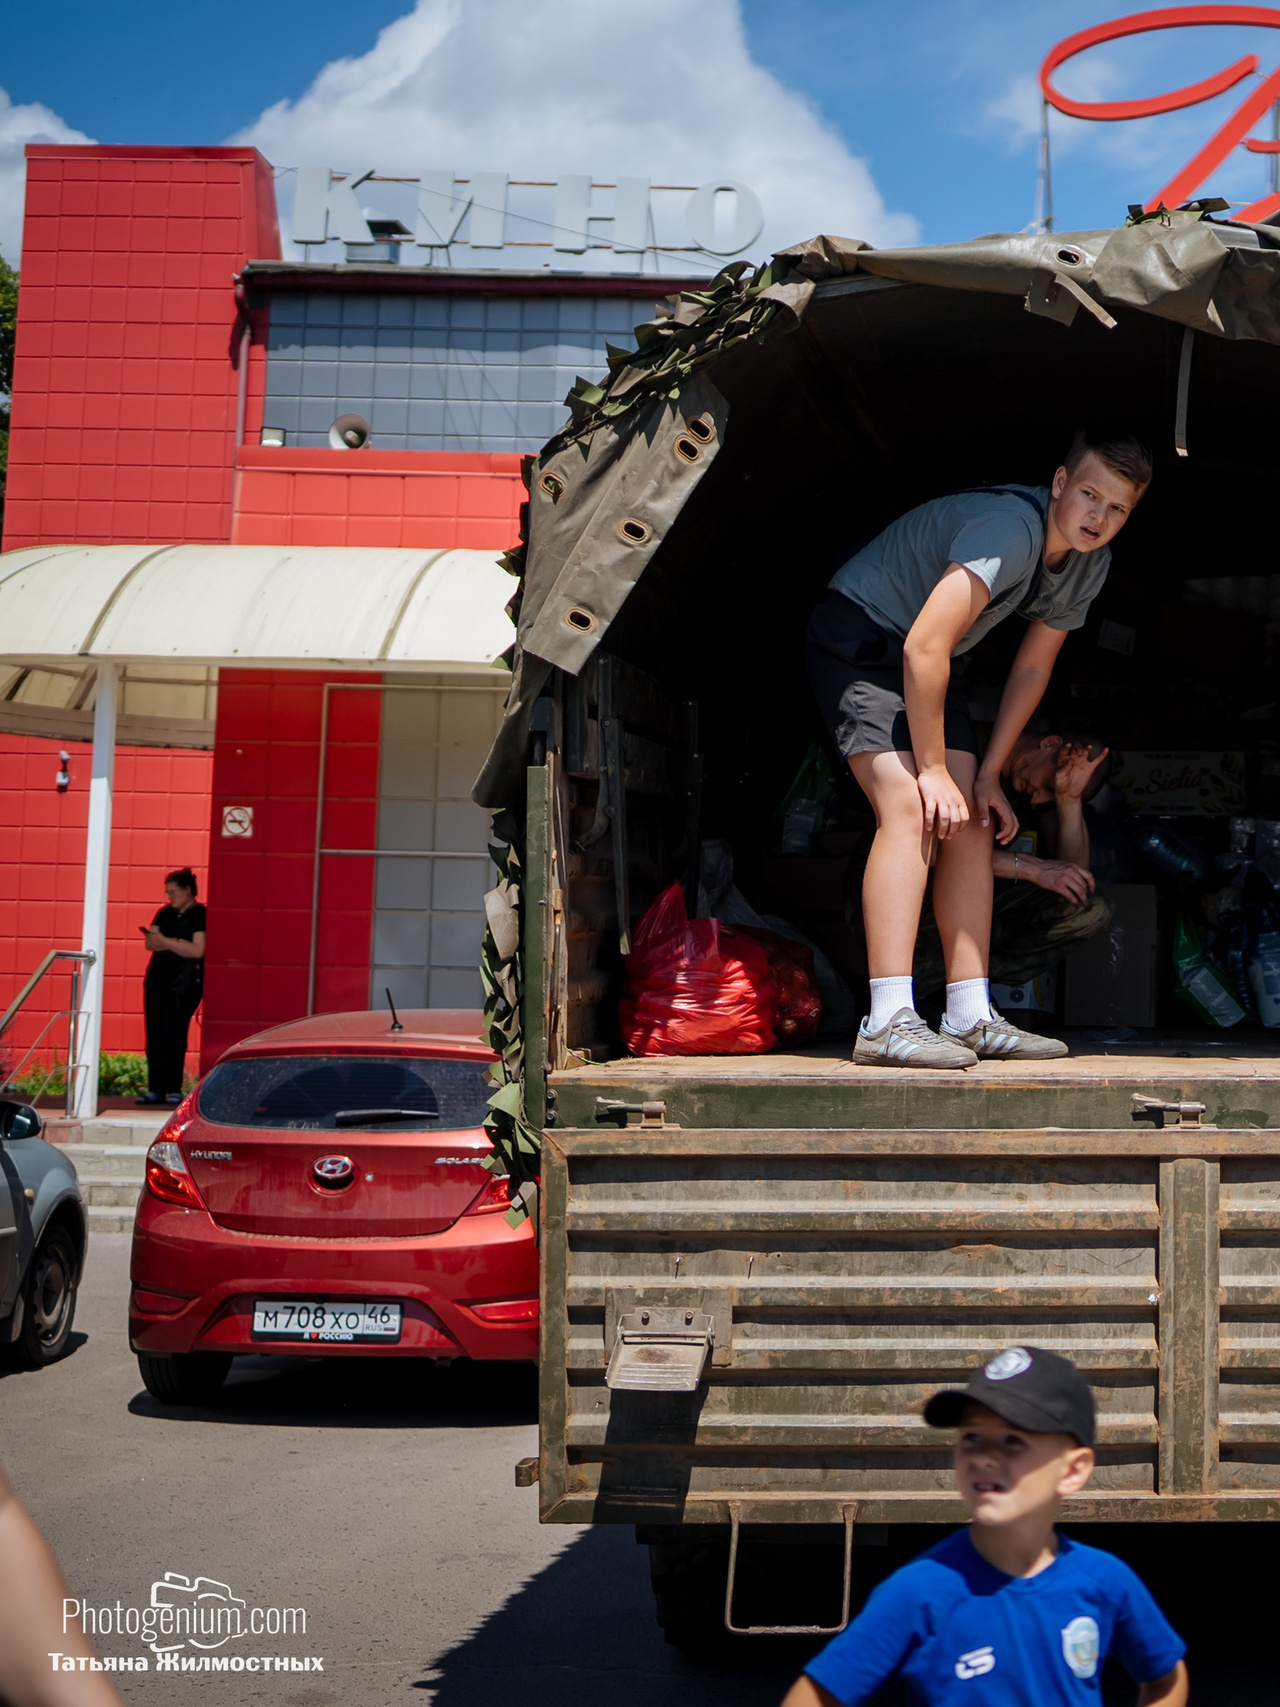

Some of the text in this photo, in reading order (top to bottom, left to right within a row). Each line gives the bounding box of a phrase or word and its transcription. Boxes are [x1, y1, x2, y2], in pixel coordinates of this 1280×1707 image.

[293, 166, 766, 256] КИНО
[190, 1150, 233, 1161] HYUNDAI
[368, 1306, 391, 1324] 46
[318, 1332, 354, 1341] РОССИЮ
